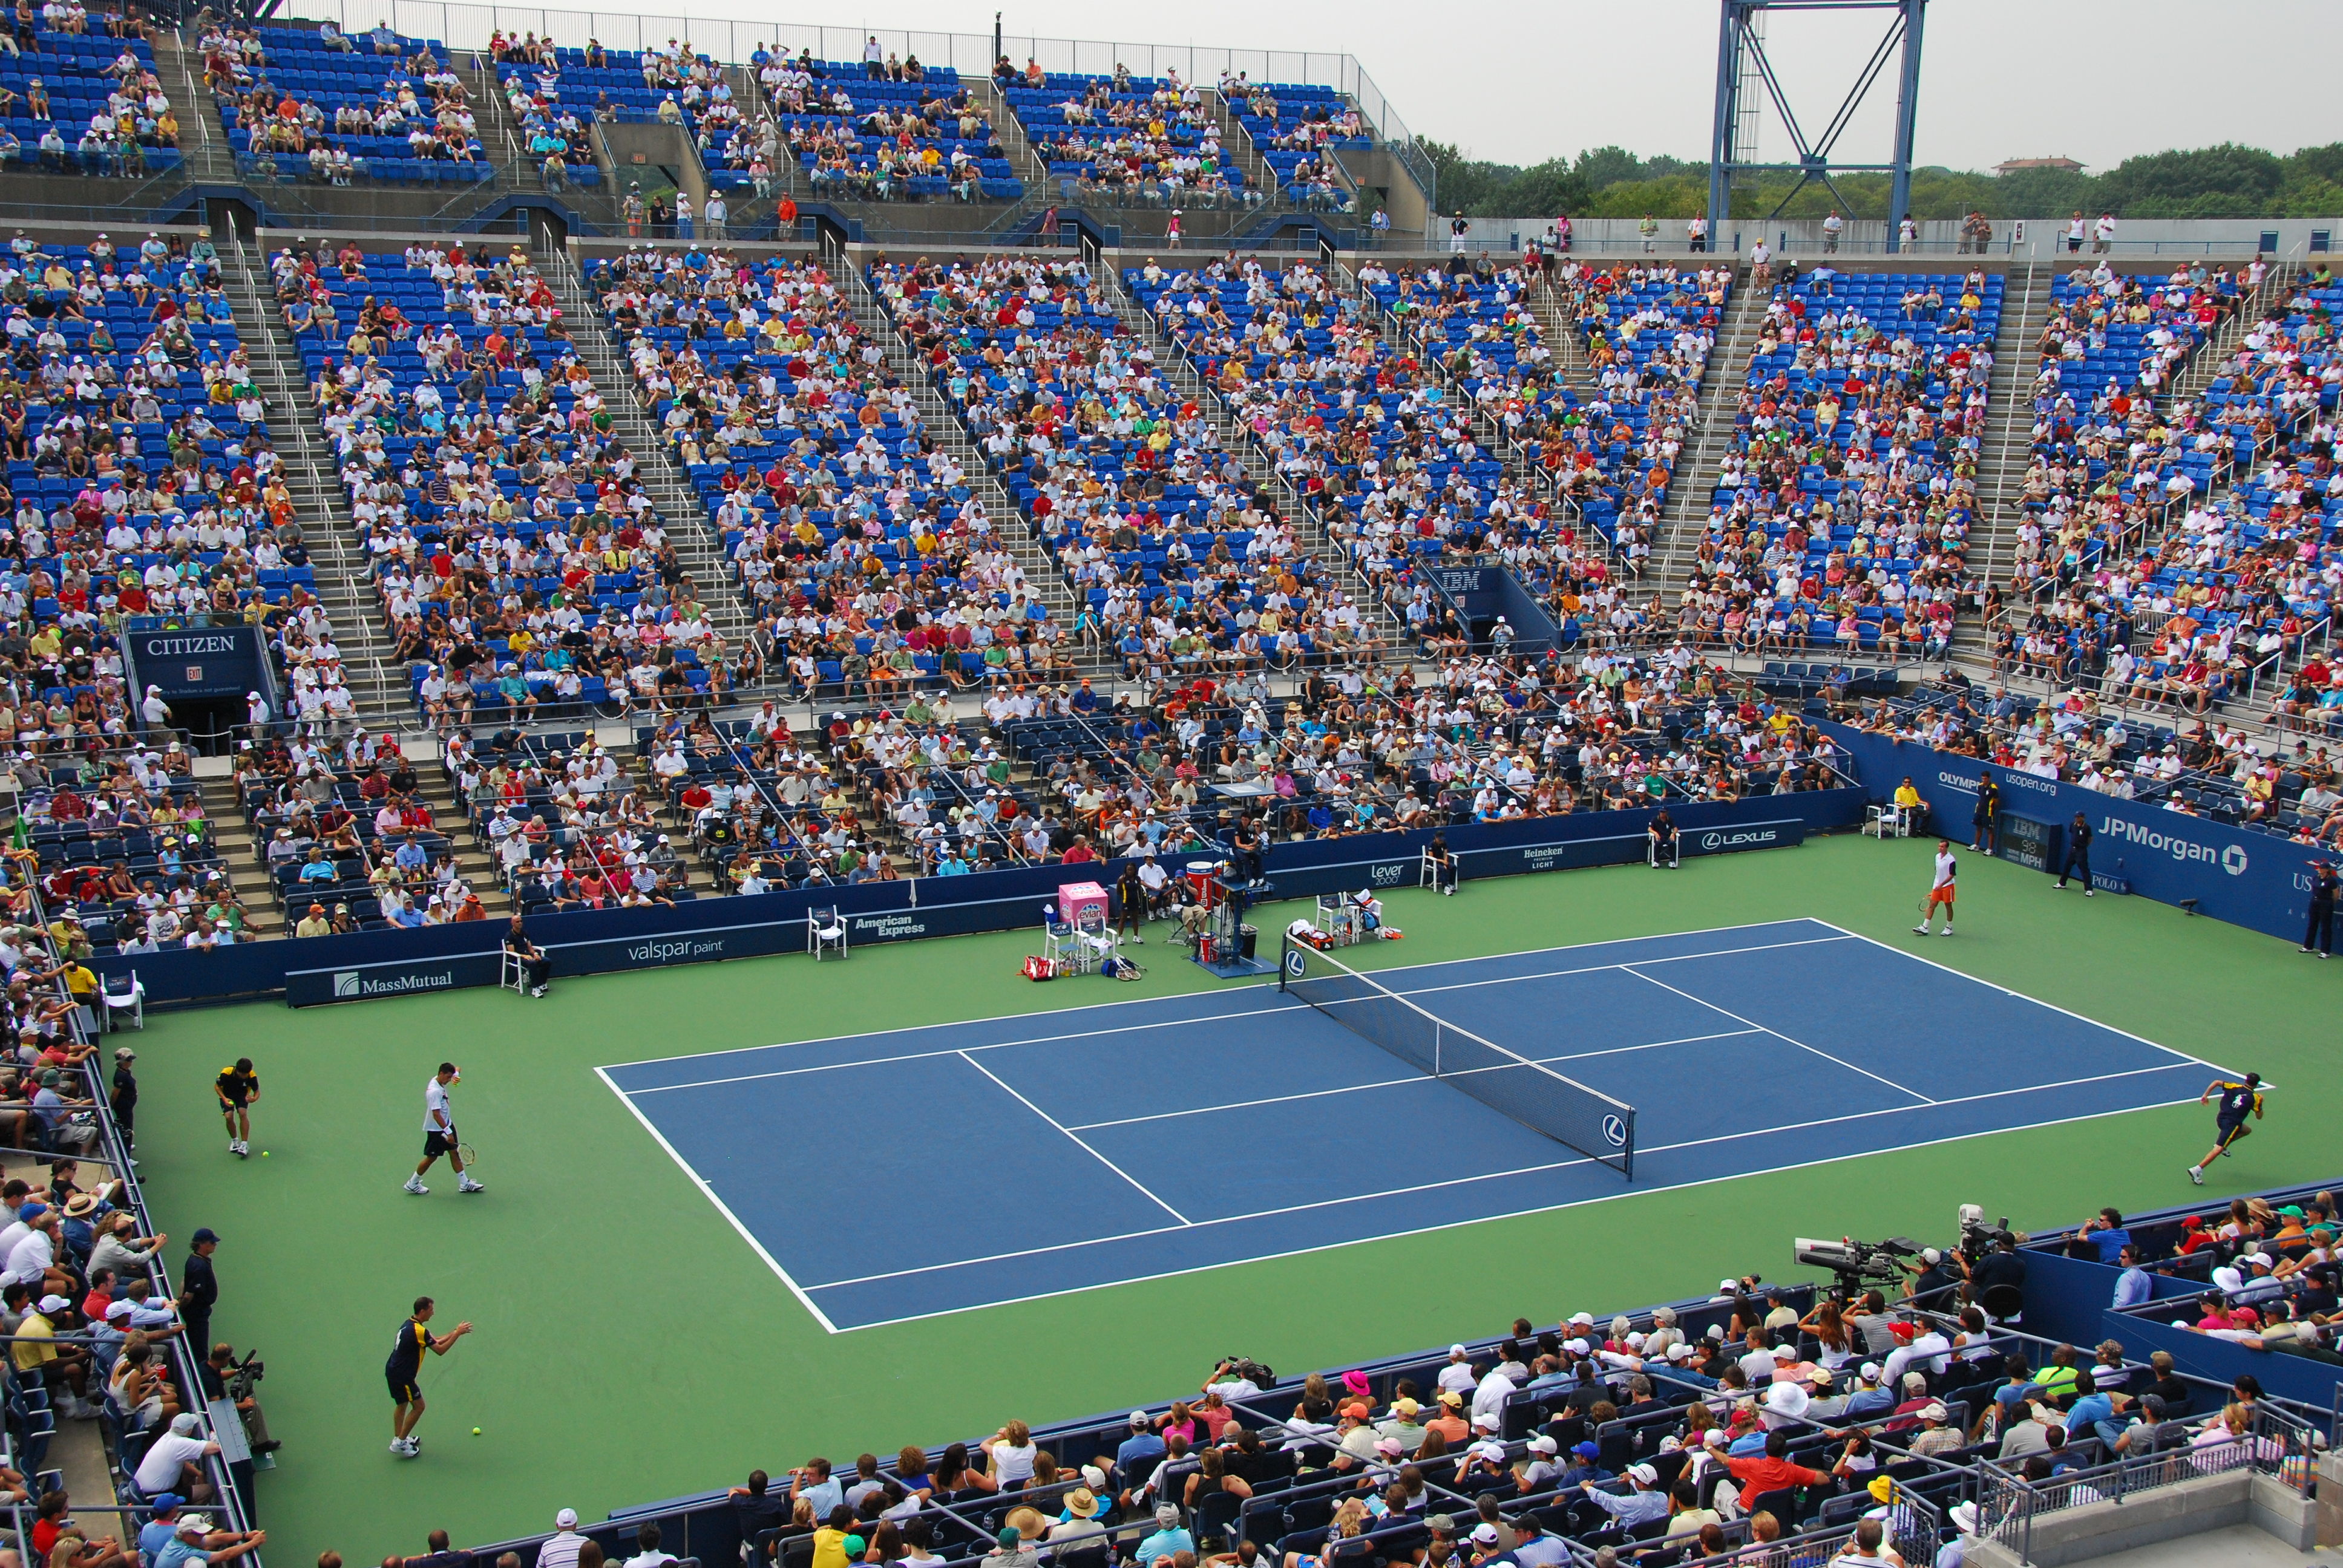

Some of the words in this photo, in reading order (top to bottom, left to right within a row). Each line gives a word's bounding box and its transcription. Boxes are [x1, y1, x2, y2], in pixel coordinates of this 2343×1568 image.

[1442, 571, 1480, 591] IBM
[148, 636, 235, 656] CITIZEN
[189, 668, 201, 680] EXIT
[2005, 773, 2057, 796] usopen.org
[2013, 818, 2042, 840] IBM
[1723, 831, 1776, 844] LEXUS
[2099, 817, 2216, 864] JPMorgan
[1524, 847, 1563, 858] Heineken
[2022, 839, 2036, 854] 98
[2020, 852, 2042, 868] MPH
[1372, 865, 1403, 878] Lever
[1375, 876, 1398, 885] 2000
[2092, 875, 2117, 890] POLO
[856, 915, 911, 929] American
[1080, 910, 1101, 919] evian
[878, 924, 925, 937] Express
[629, 941, 692, 961] valspar
[694, 940, 723, 956] paint
[362, 971, 453, 993] MassMutual
